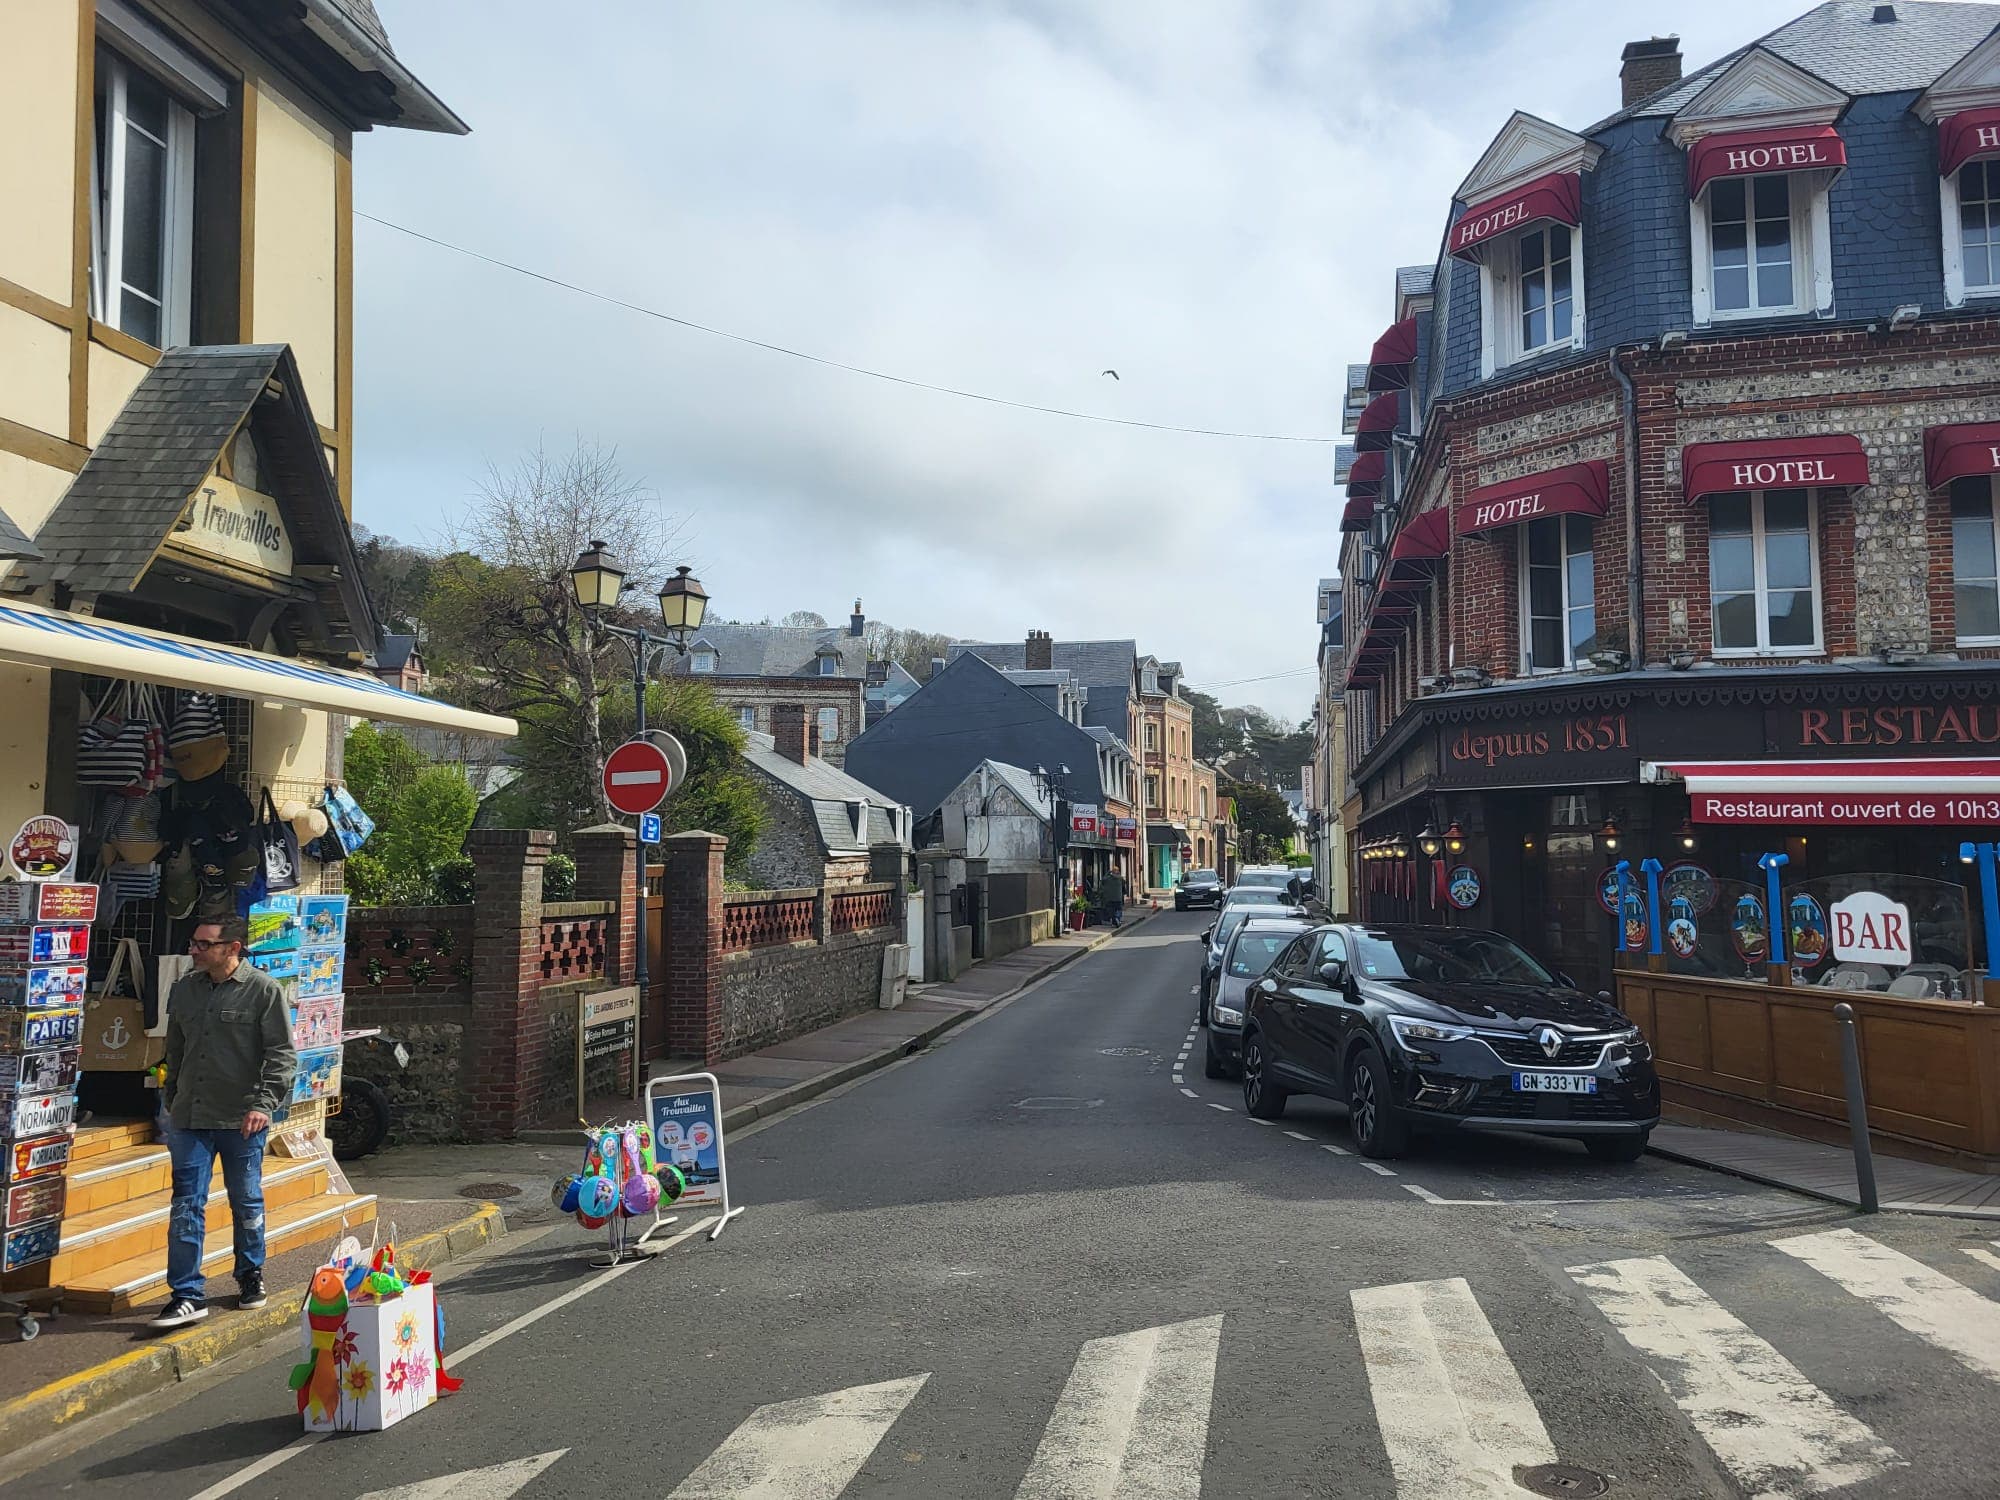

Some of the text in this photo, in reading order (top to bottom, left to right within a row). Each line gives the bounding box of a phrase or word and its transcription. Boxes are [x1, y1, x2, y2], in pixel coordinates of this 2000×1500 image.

[1726, 144, 1827, 171] HOTEL
[1459, 202, 1531, 245] HOTEL
[1731, 460, 1836, 486] HOTEL
[202, 488, 281, 551] Trouvailles
[1474, 494, 1546, 527] HOTEL
[1452, 713, 1631, 767] depuis 1851
[1706, 799, 1825, 818] Restaurant
[1831, 800, 1902, 818] ouvert
[1908, 800, 1936, 818] de
[1835, 912, 1908, 951] BAR
[31, 1018, 76, 1040] PARIS
[1522, 1074, 1588, 1091] GN-333-VT
[661, 1104, 707, 1117] Trouvailles
[673, 1097, 690, 1108] Aux
[20, 1105, 71, 1130] NORMANDY
[31, 1143, 67, 1167] NORMANDIE
